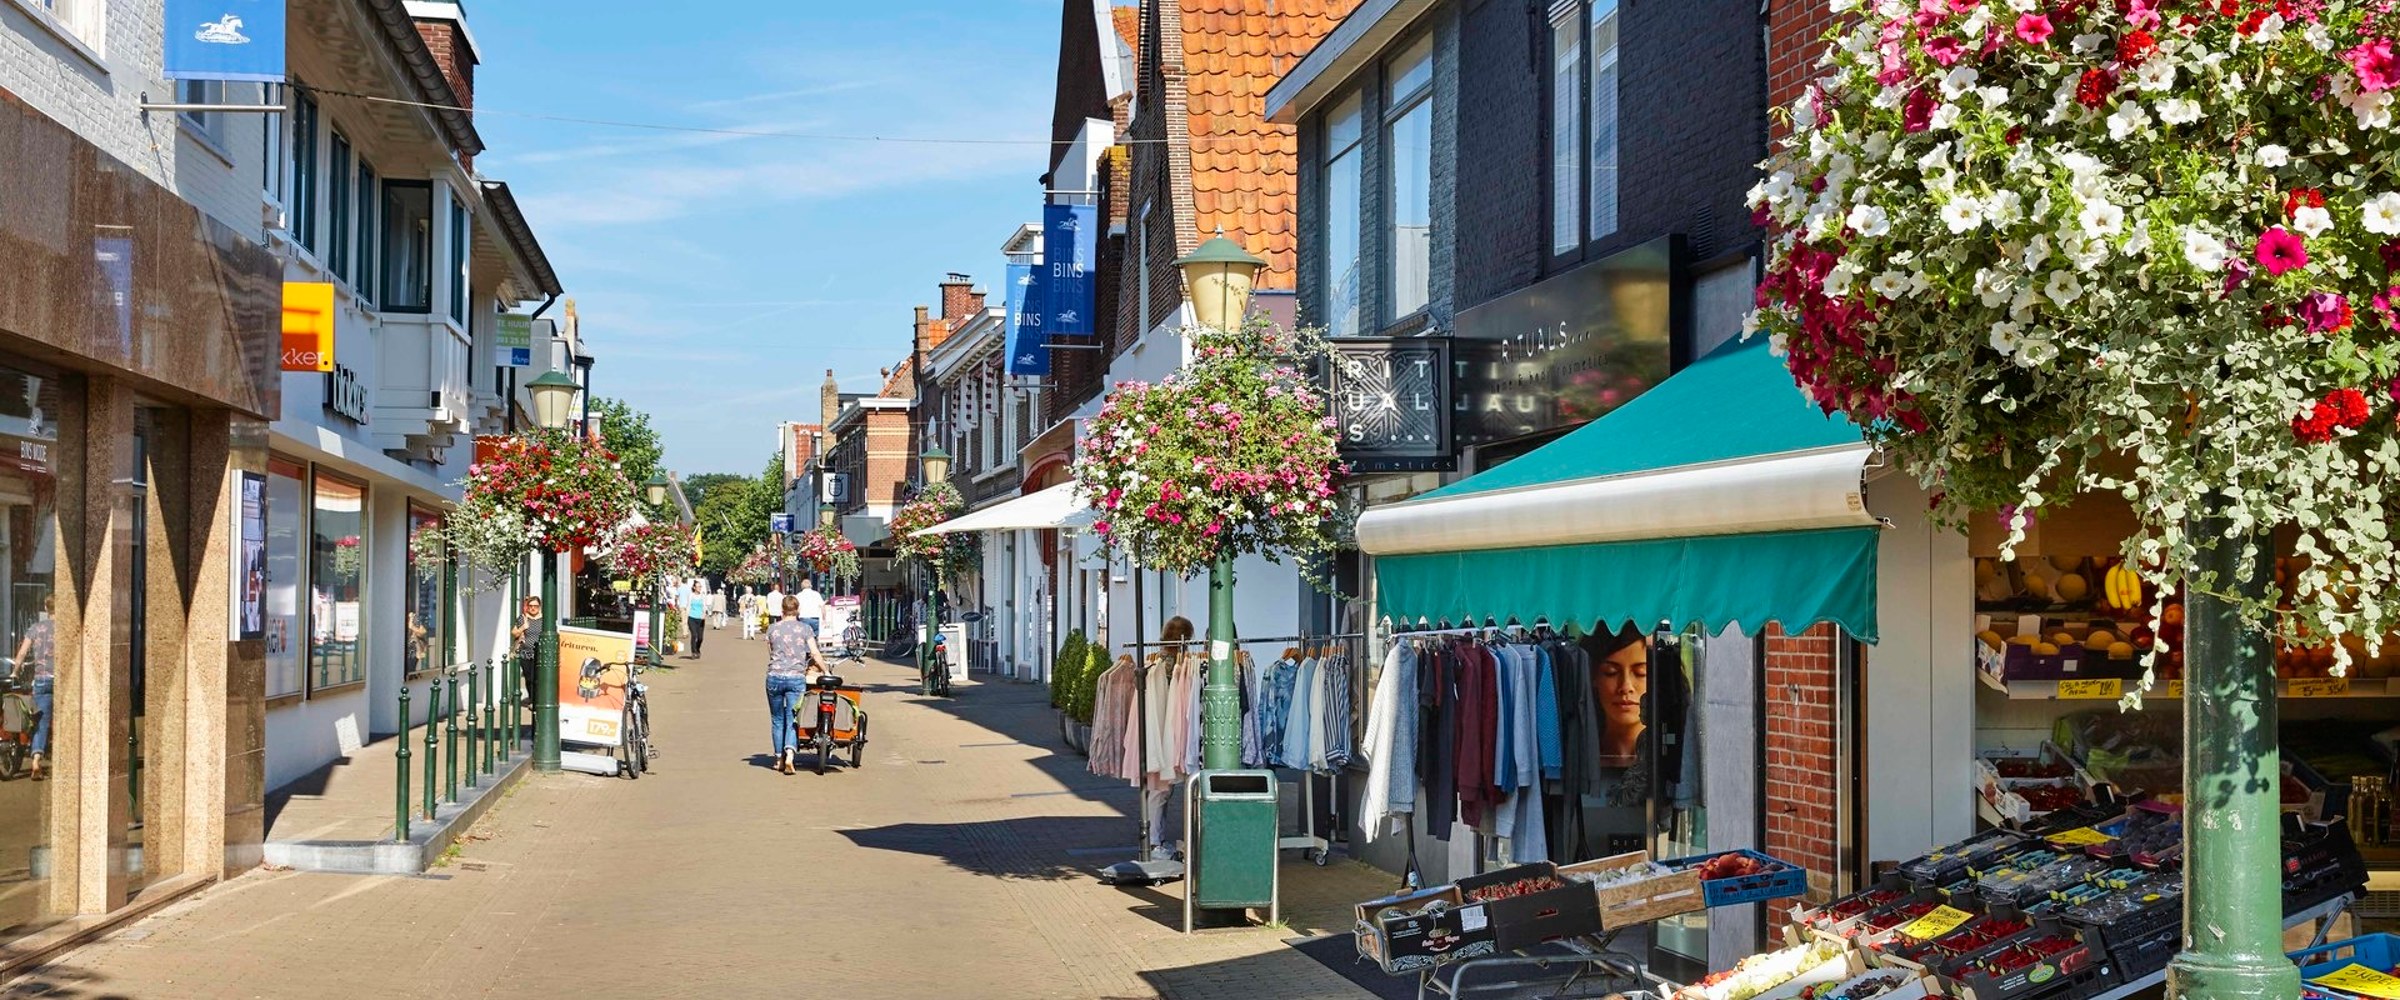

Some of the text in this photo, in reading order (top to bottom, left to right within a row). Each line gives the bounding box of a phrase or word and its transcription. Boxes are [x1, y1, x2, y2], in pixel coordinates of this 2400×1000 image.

[1053, 262, 1084, 278] BINS
[1014, 312, 1041, 326] BINS
[21, 441, 47, 462] BINS MODE
